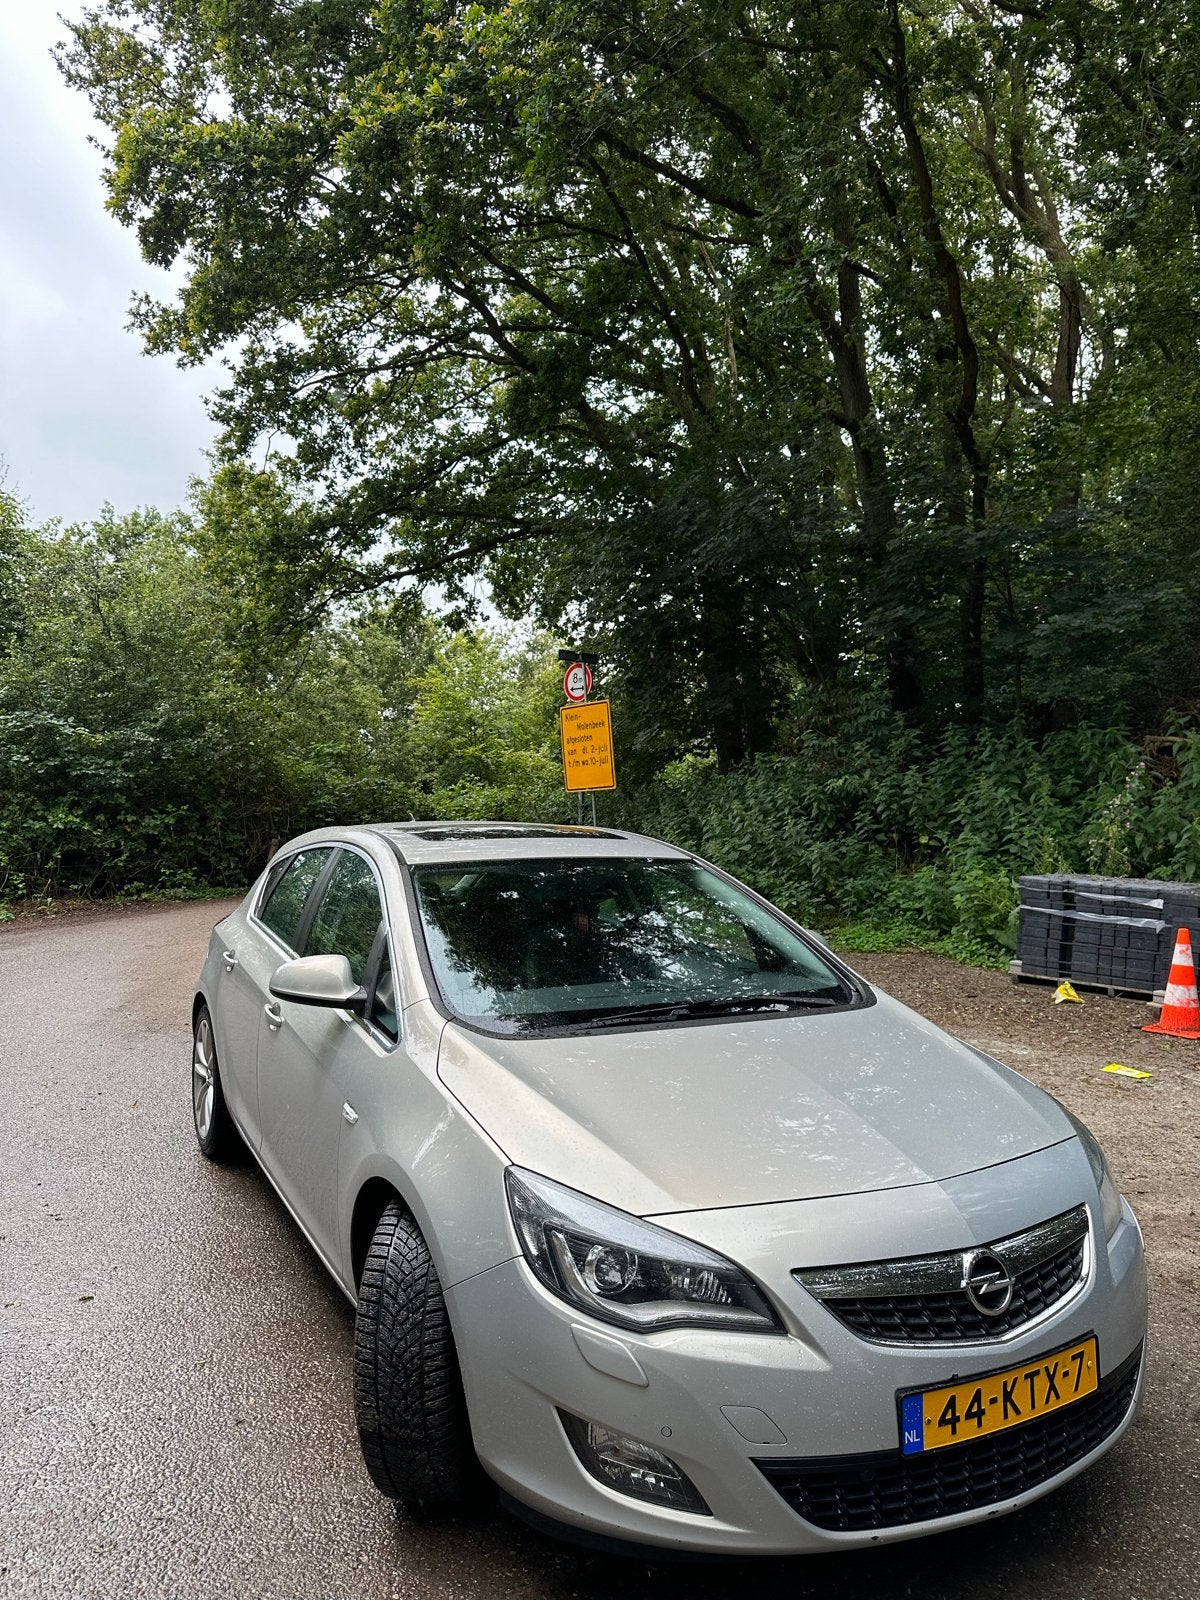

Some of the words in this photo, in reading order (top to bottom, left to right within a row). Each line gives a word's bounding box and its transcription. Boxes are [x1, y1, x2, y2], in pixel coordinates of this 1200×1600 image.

[577, 720, 605, 730] Molenbeek
[566, 734, 592, 746] afgesloten
[938, 1350, 1085, 1435] 44-KTX-7
[904, 1430, 920, 1444] NL
